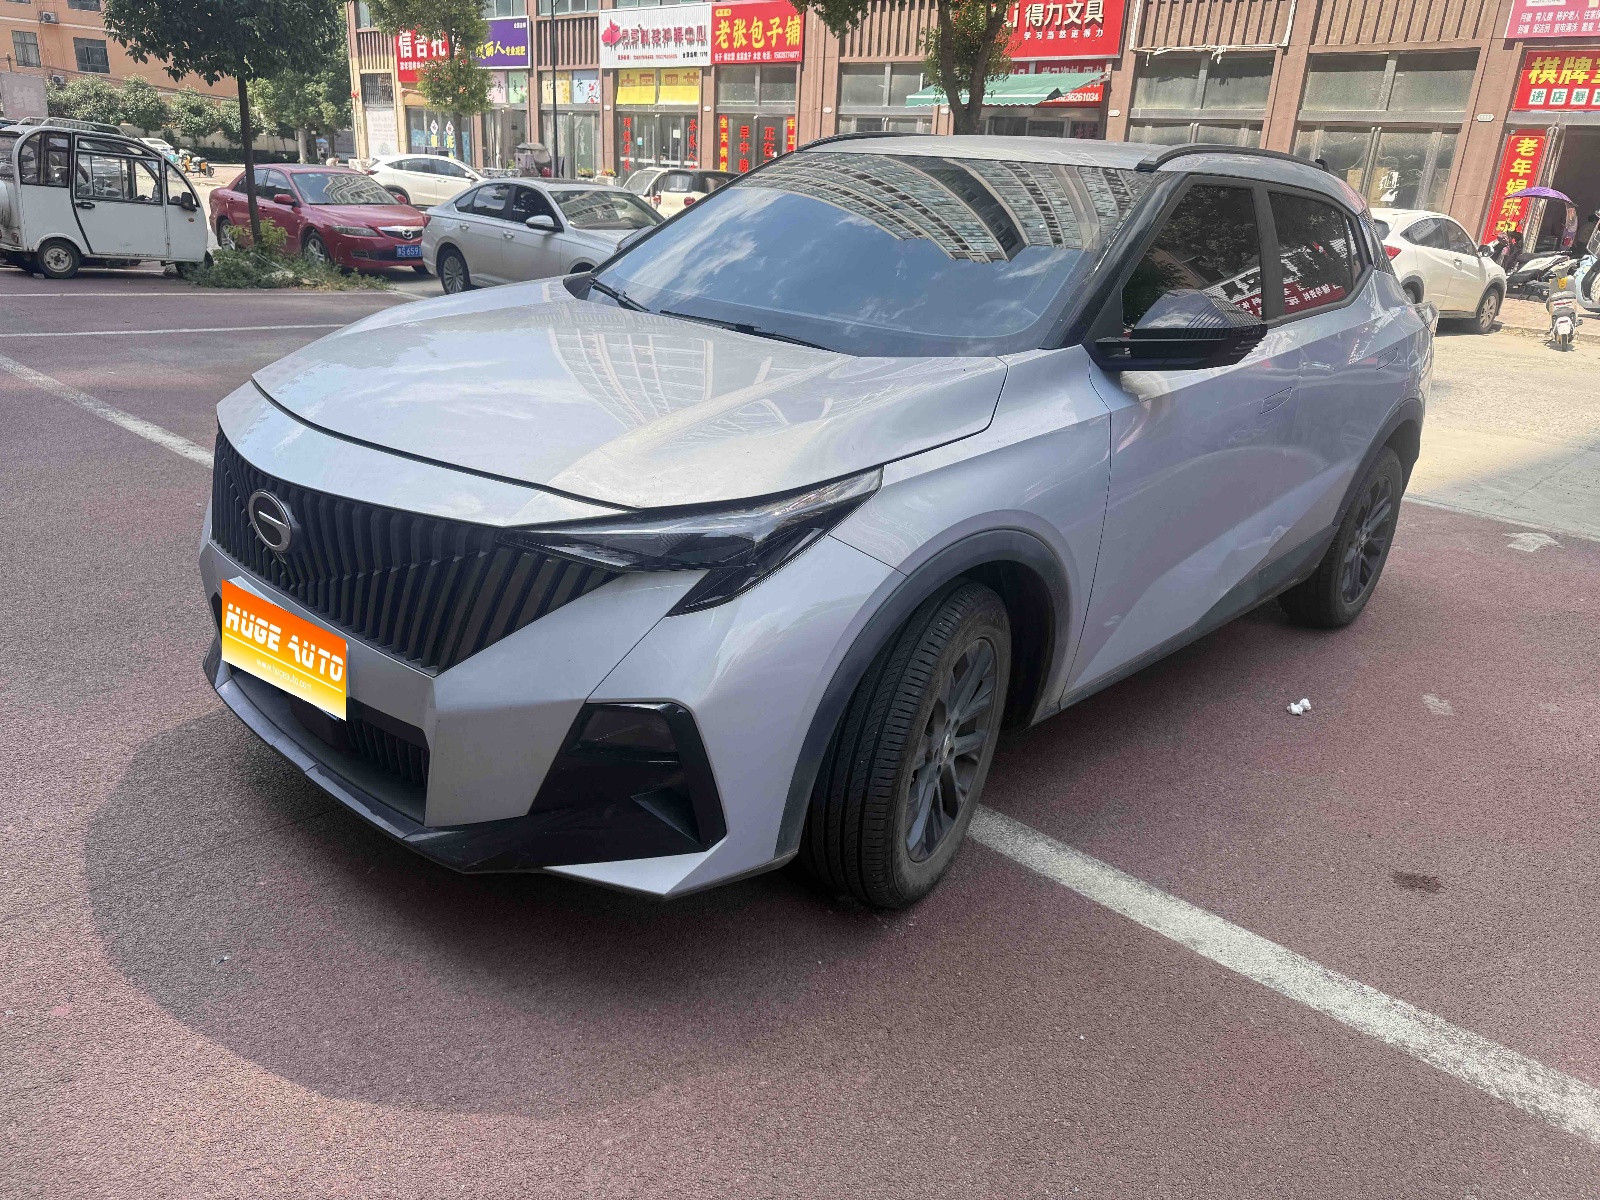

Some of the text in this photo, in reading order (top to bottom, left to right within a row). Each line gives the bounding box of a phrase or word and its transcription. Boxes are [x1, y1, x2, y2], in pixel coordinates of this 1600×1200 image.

[1025, 0, 1104, 28] 得力文具
[715, 15, 801, 49] 老张包子铺
[1023, 29, 1104, 41] 学习当然更得力
